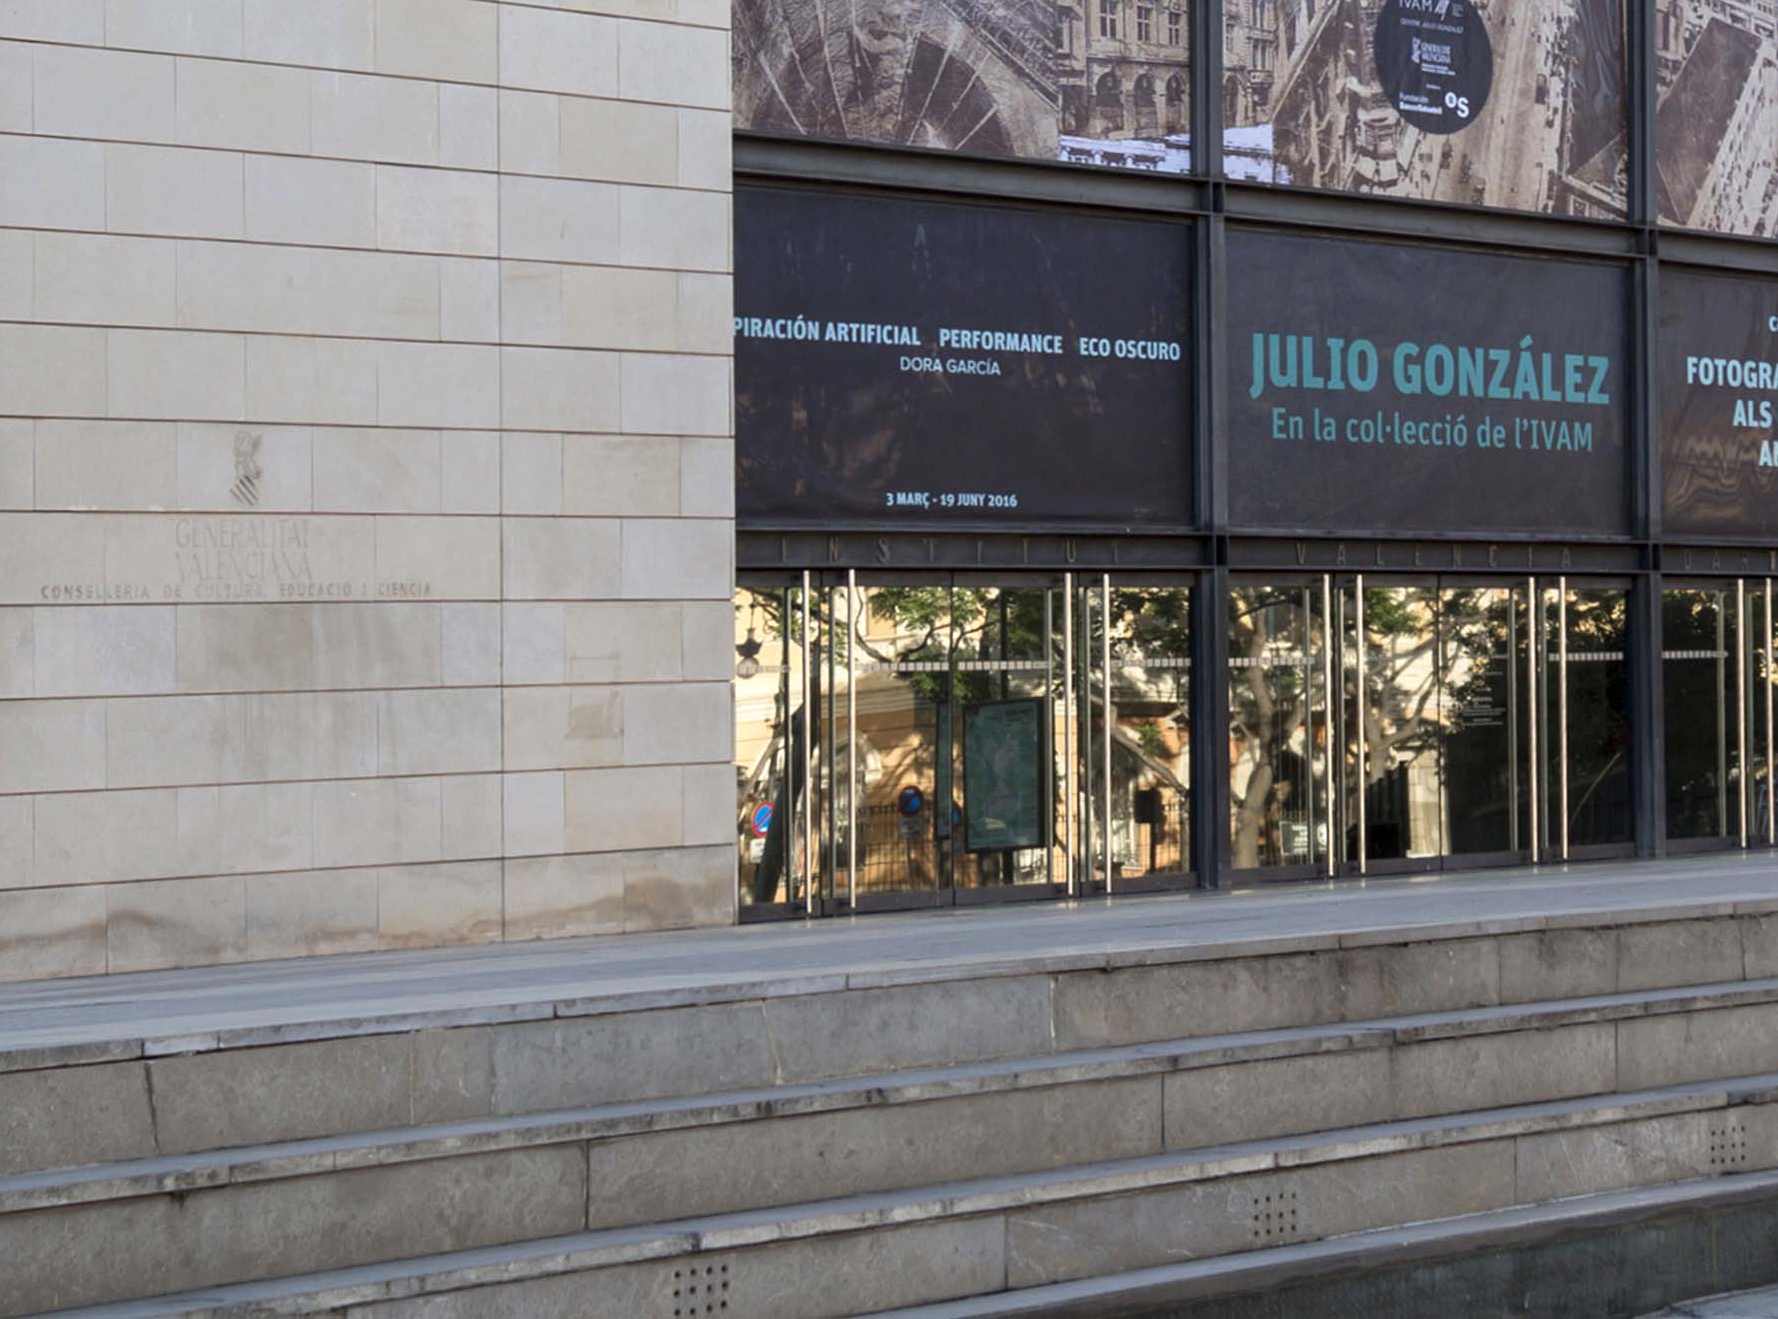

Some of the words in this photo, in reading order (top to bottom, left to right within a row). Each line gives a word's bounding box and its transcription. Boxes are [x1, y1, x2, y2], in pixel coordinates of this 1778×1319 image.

[825, 322, 921, 346] ARTIFICIAL
[939, 328, 1063, 354] PERFORMANCE
[1079, 337, 1110, 357] ECO
[1115, 339, 1180, 361] OSCURO
[900, 356, 942, 372] DORA
[946, 357, 1001, 376] GARCÍA
[1249, 332, 1378, 399] JULIO
[1392, 334, 1610, 405] GONZÁLEZ
[1272, 407, 1303, 439] En
[1313, 408, 1336, 441] la
[1476, 416, 1506, 448] de
[1732, 399, 1772, 428] ALS
[886, 492, 894, 506] 3
[896, 492, 930, 509] MARÇ
[940, 493, 955, 507] 19
[957, 493, 986, 506] JUNY
[988, 495, 1018, 507] 2016
[175, 519, 311, 548] GENERALITAT
[40, 584, 150, 600] CONSELLERIA
